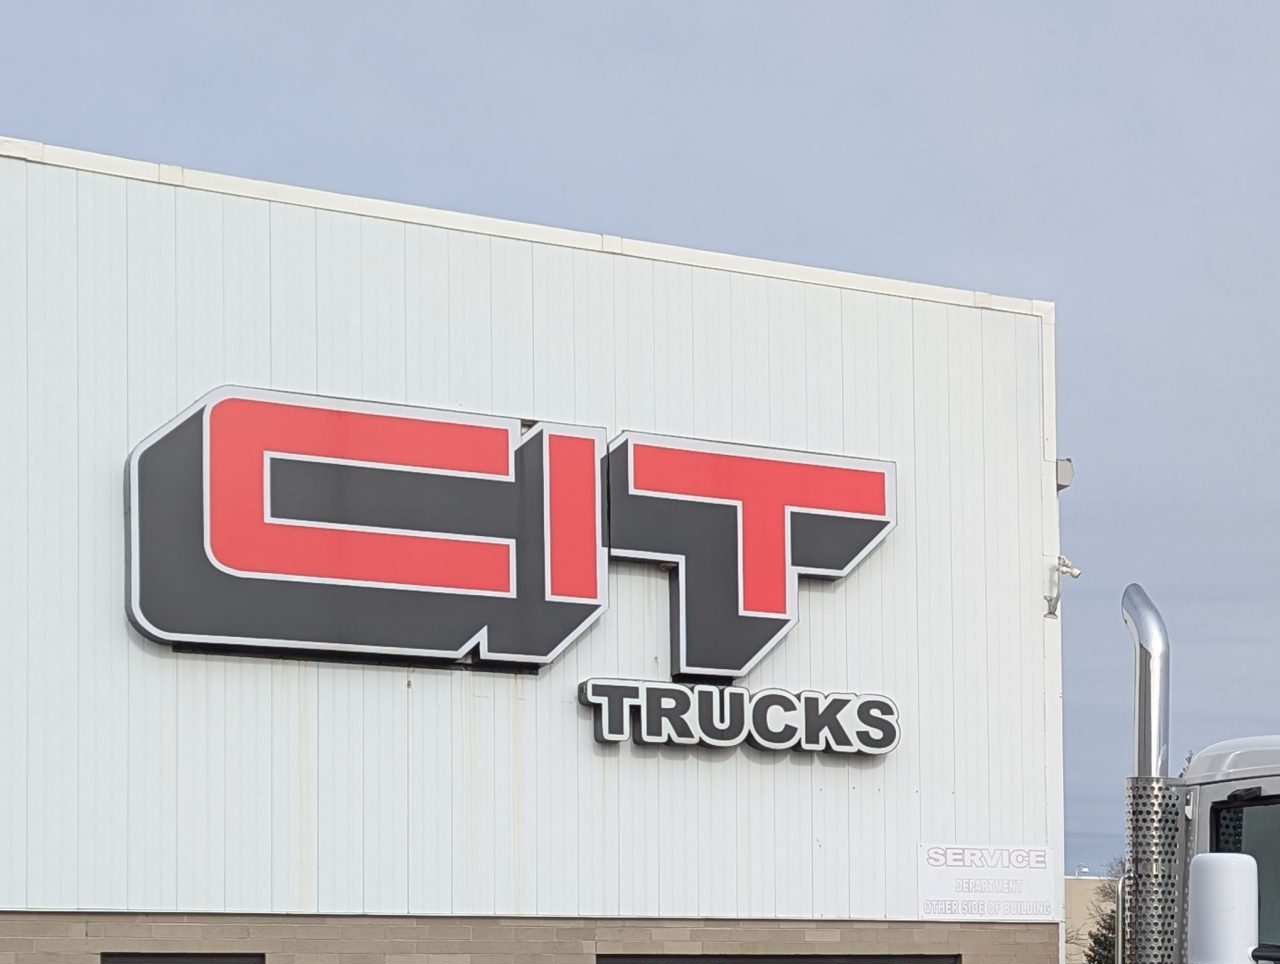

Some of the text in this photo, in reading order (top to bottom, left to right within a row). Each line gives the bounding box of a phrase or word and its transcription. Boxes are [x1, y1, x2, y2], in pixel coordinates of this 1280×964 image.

[201, 394, 890, 619] CIT
[590, 682, 898, 750] TRUCKS
[927, 847, 1047, 869] SERVICE
[955, 878, 1023, 893] DEPARTMENT
[923, 899, 1051, 916] OTHER SIDE OF BUILDING
